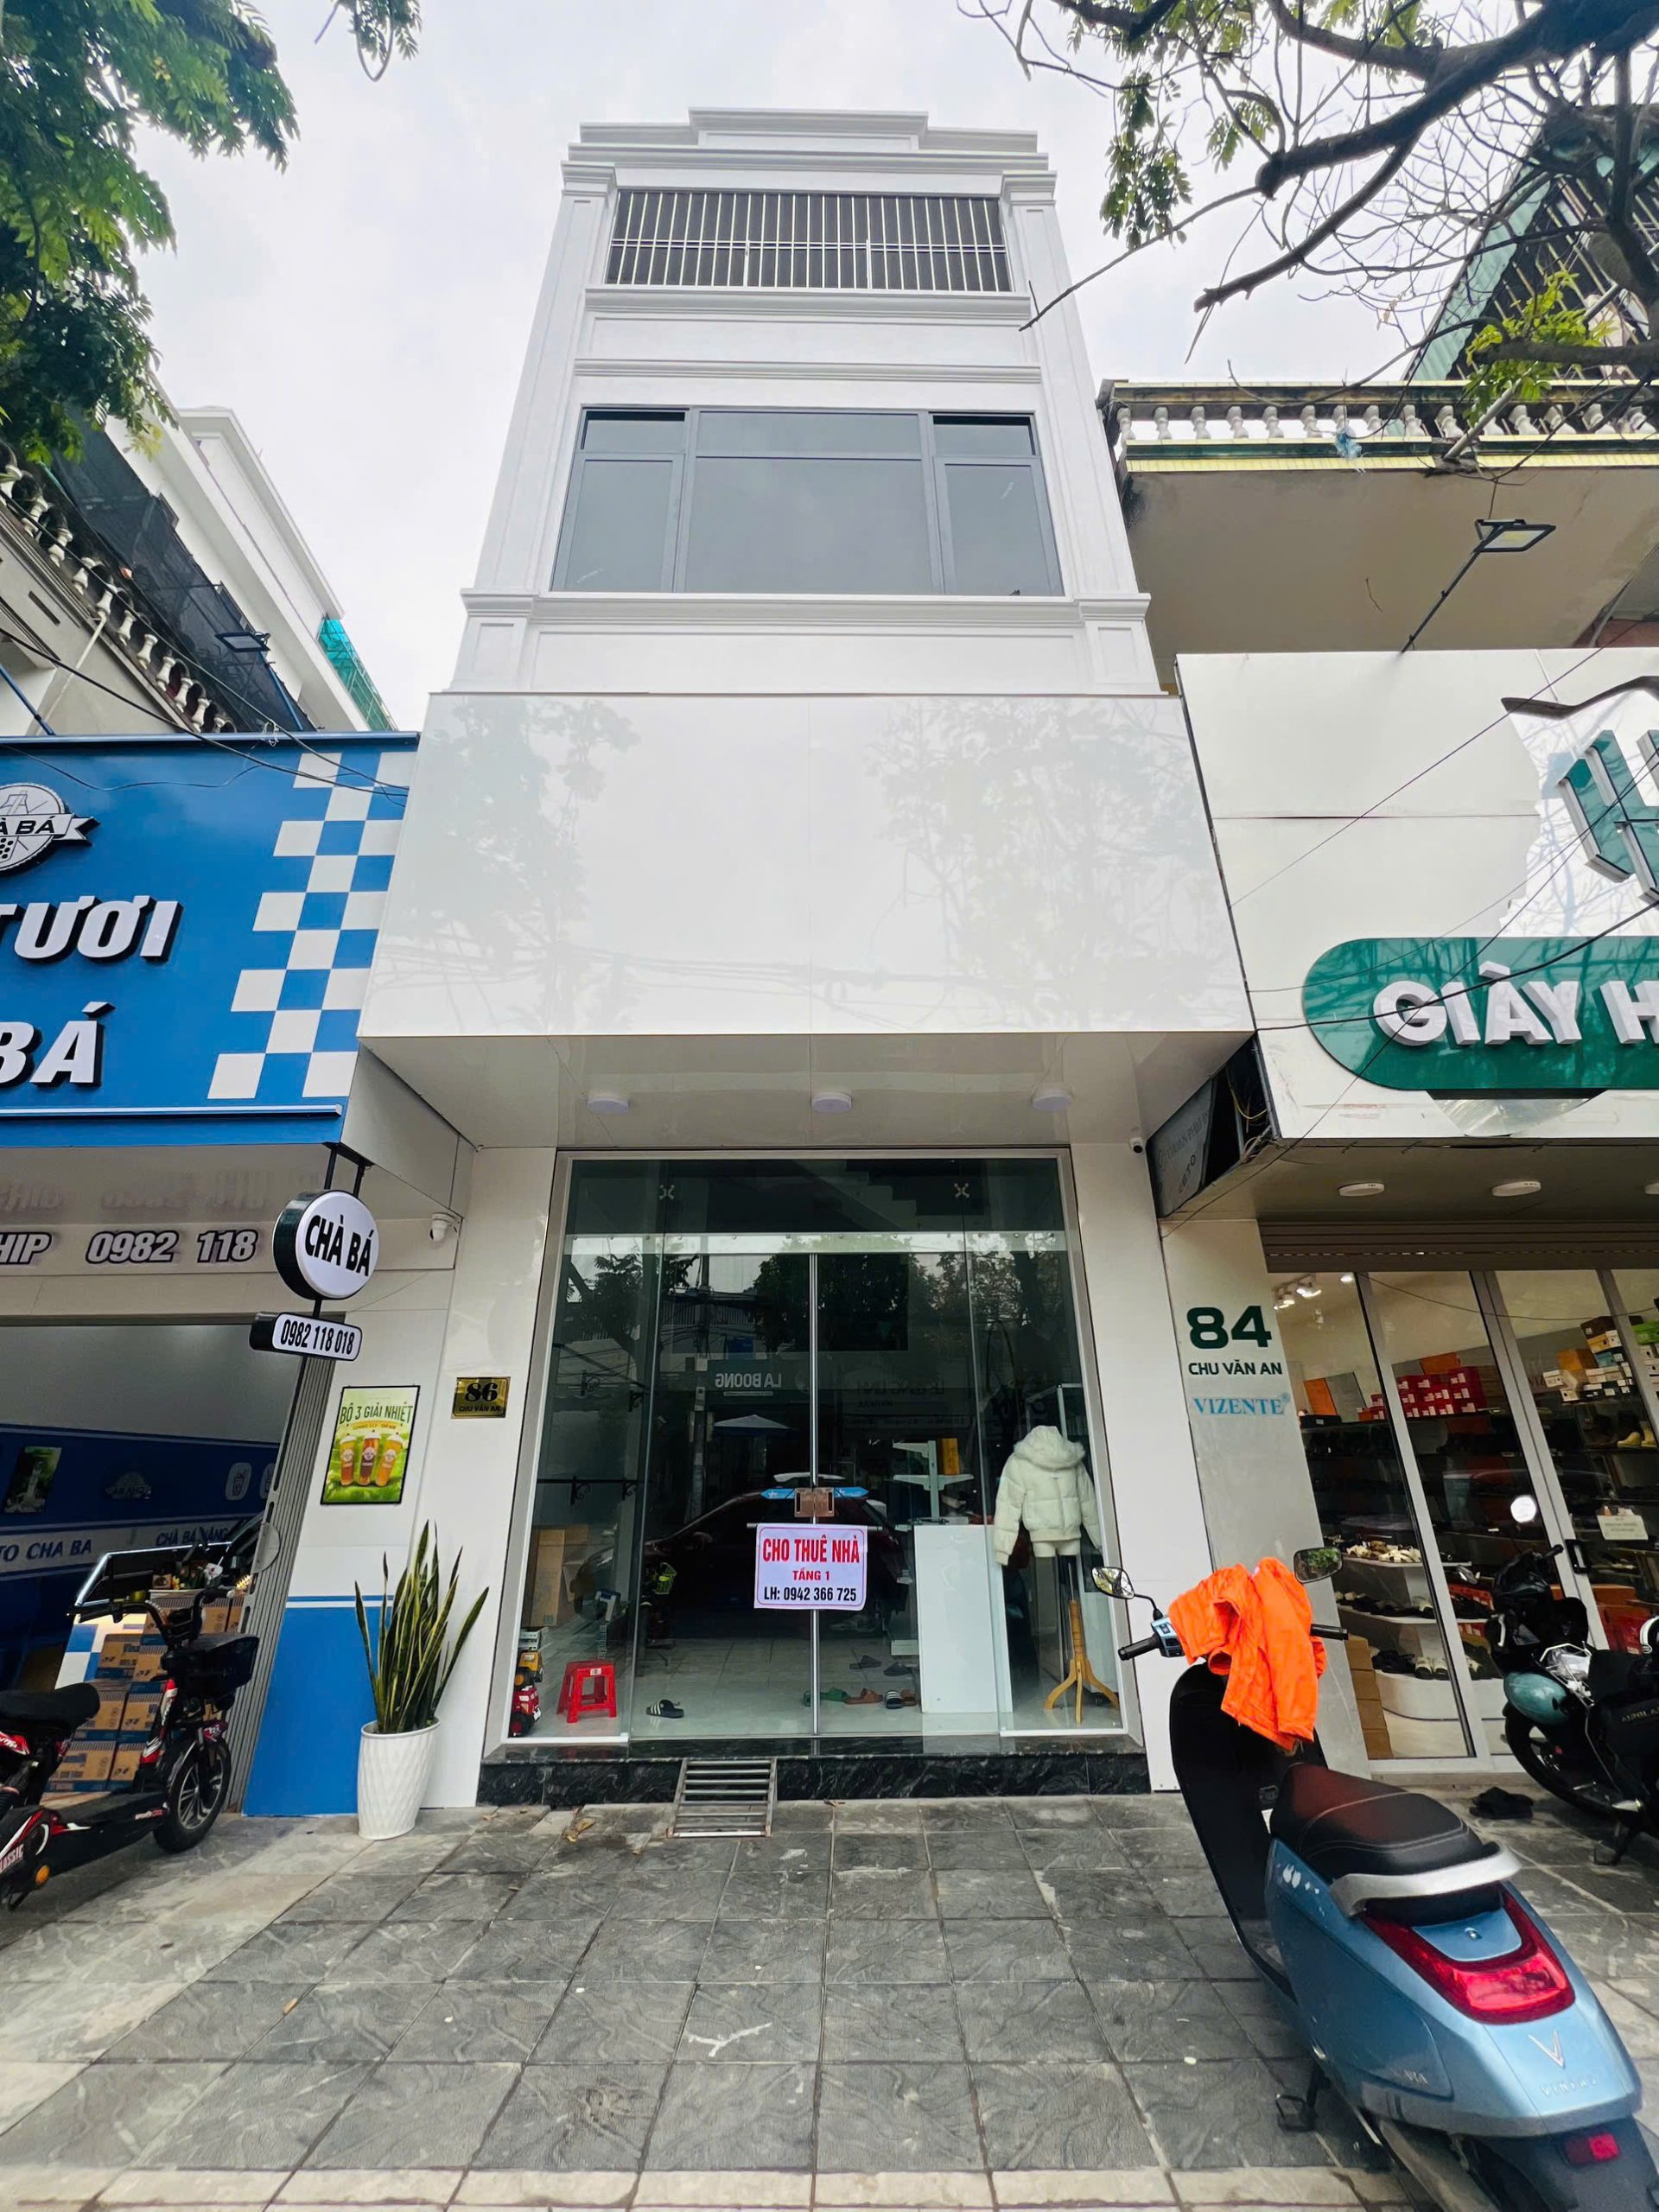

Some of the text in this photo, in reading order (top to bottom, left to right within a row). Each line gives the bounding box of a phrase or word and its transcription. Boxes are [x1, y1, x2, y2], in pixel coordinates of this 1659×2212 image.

[16, 816, 55, 835] BÁ
[1374, 961, 1582, 1046] GIÀY
[86, 1230, 180, 1263] 0982
[197, 1230, 258, 1262] 118
[305, 1214, 374, 1276] CHÀ BÁ
[281, 1319, 355, 1355] 0982 118 018
[1186, 1306, 1272, 1349] 84
[1188, 1359, 1282, 1375] CHU VĂN AN
[465, 1382, 498, 1402] 86
[763, 1535, 860, 1563] CHO THUÊ NHÀ
[825, 1571, 830, 1581] 1
[764, 1586, 857, 1601] LH: 0942 366 725
